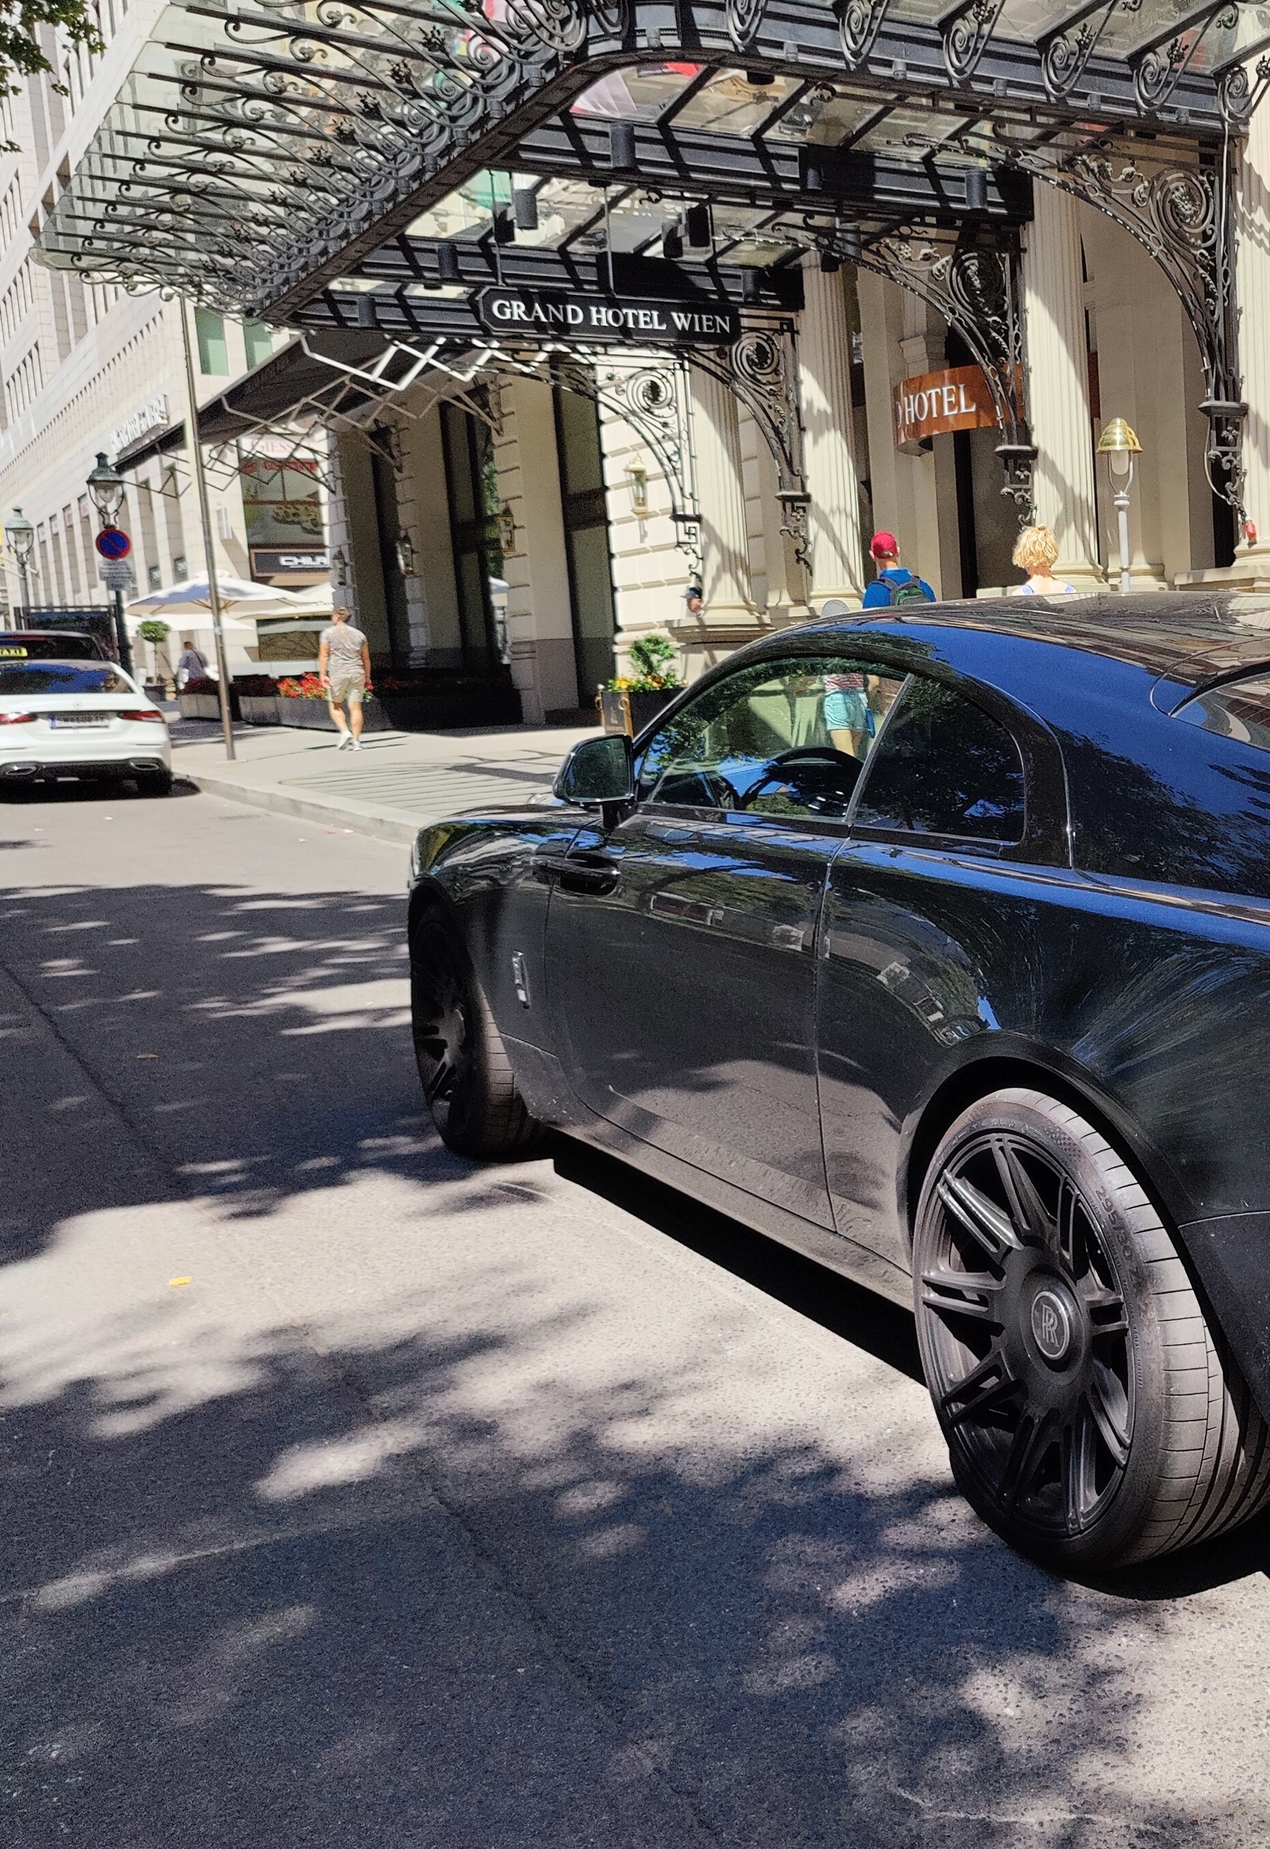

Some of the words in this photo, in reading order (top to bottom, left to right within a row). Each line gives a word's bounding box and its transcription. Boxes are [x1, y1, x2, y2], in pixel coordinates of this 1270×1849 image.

[492, 300, 583, 325] GRAND
[589, 306, 666, 331] HOTEL
[671, 311, 731, 334] WIEN
[903, 383, 976, 425] HOTEL
